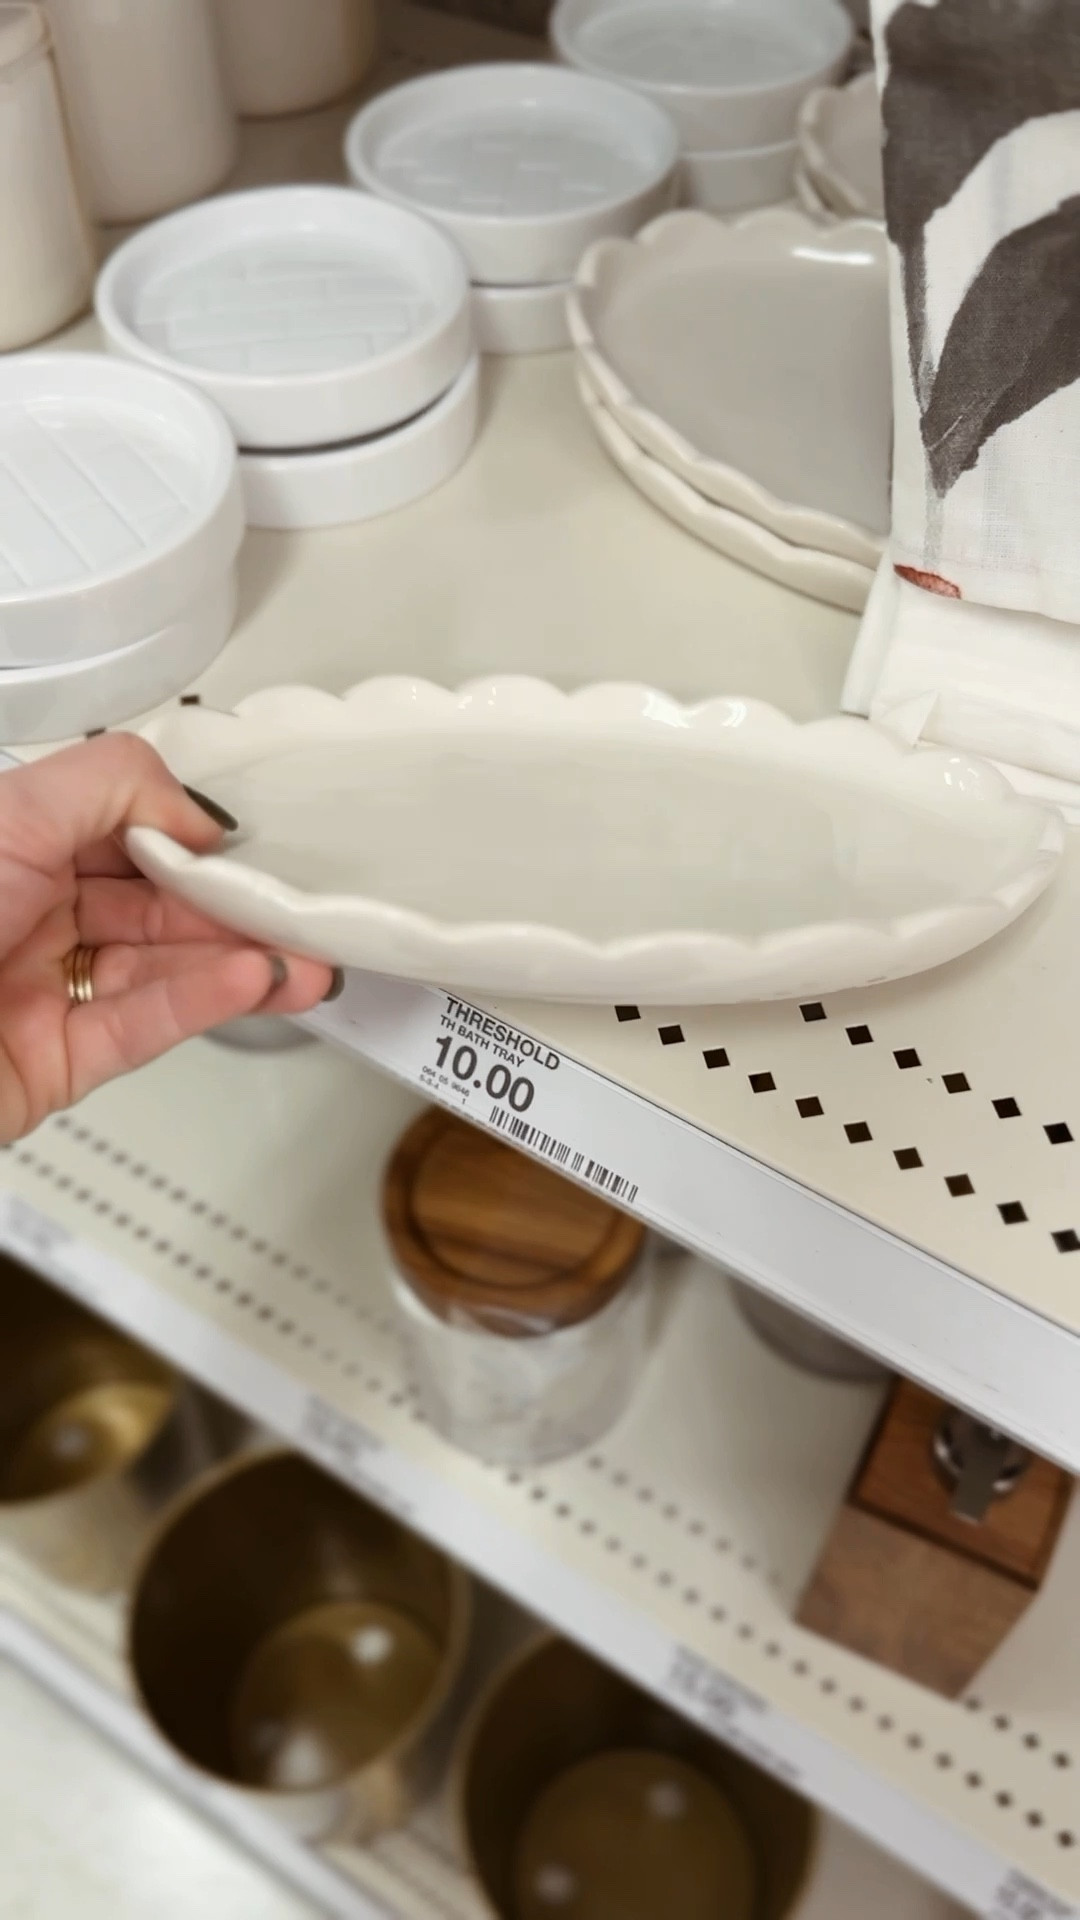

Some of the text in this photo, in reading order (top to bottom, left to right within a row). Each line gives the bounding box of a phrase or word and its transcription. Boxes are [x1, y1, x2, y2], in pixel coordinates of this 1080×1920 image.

[440, 1014, 524, 1068] TH BATH TRAY
[446, 997, 560, 1070] THRESHOLD
[436, 1035, 535, 1112] 10.00
